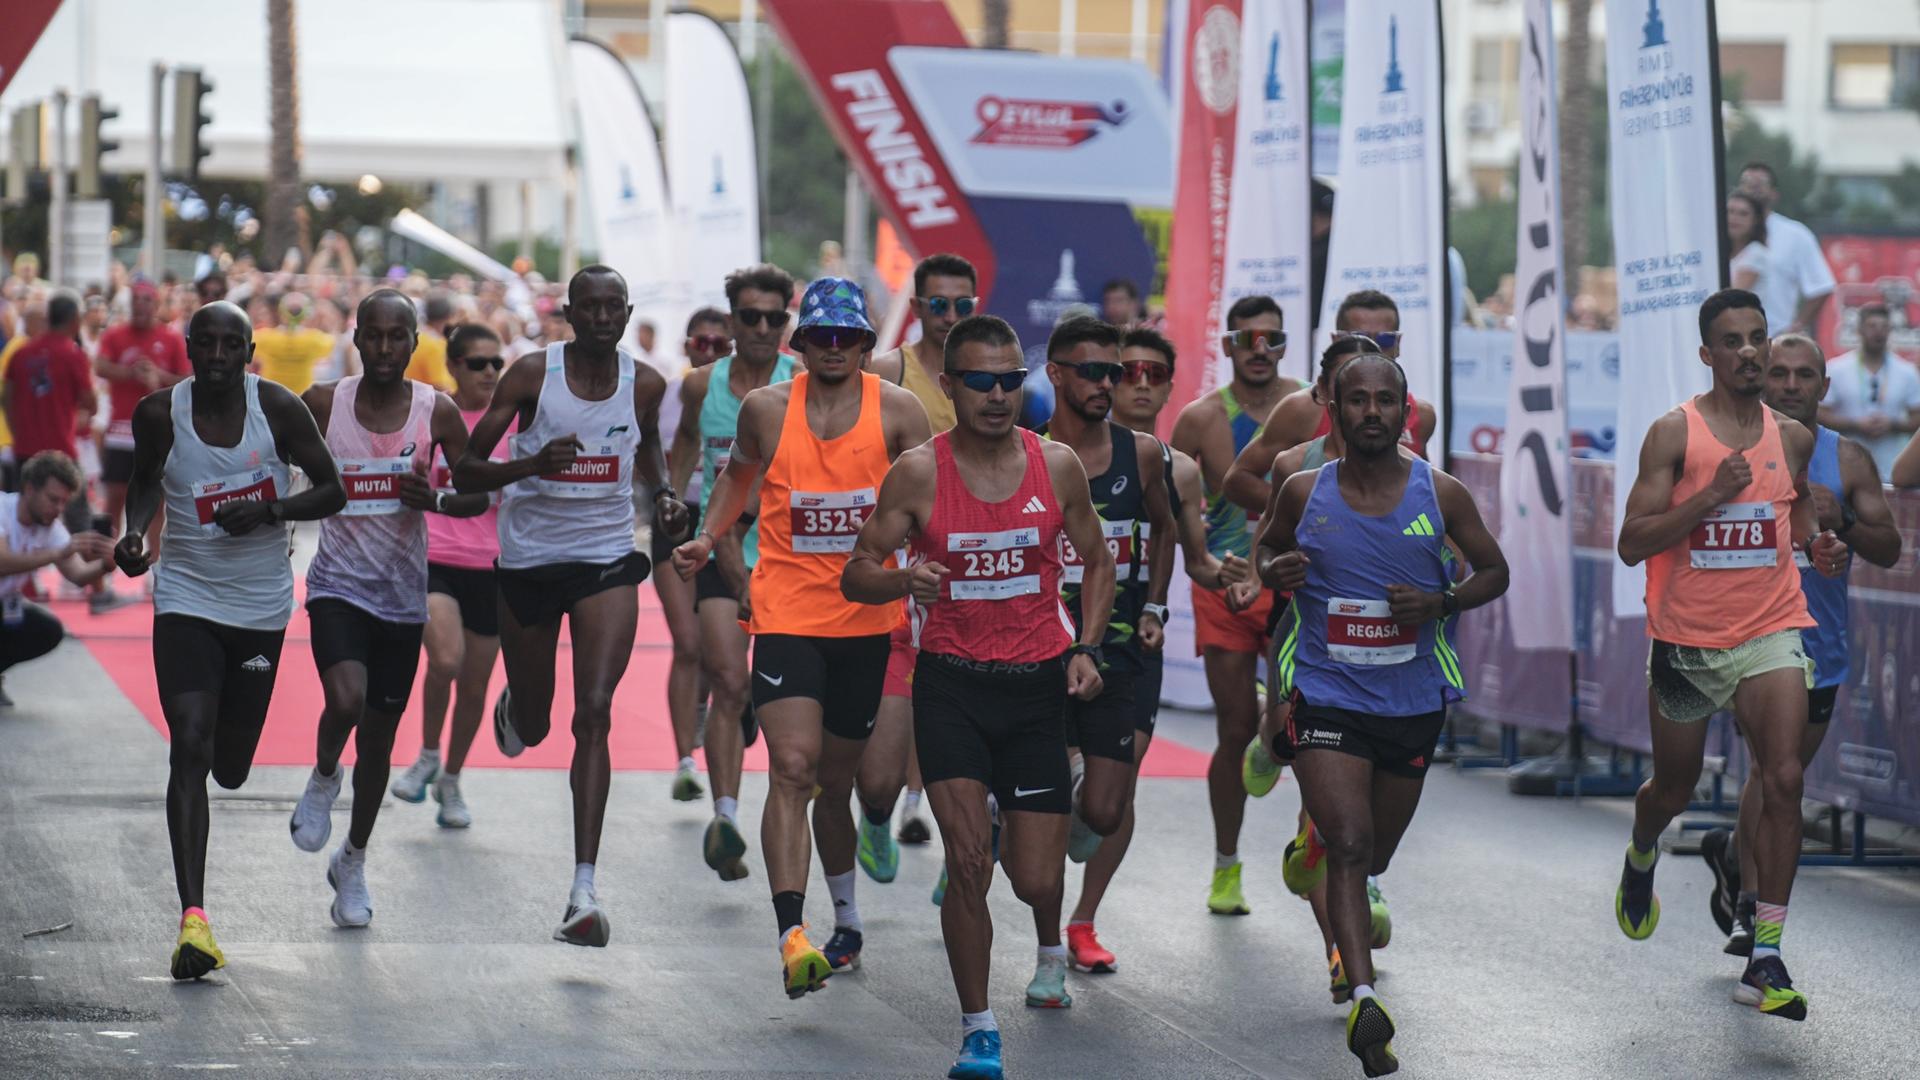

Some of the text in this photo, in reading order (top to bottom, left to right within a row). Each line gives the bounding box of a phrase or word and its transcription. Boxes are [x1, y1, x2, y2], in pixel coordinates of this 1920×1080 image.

[831, 68, 959, 230] FINISH
[354, 477, 392, 493] MUTAİ
[804, 509, 863, 533] 3525
[1704, 521, 1764, 546] 1778
[963, 549, 1025, 577] 2345
[1346, 623, 1400, 638] REGASA
[991, 662, 1041, 674] PRO
